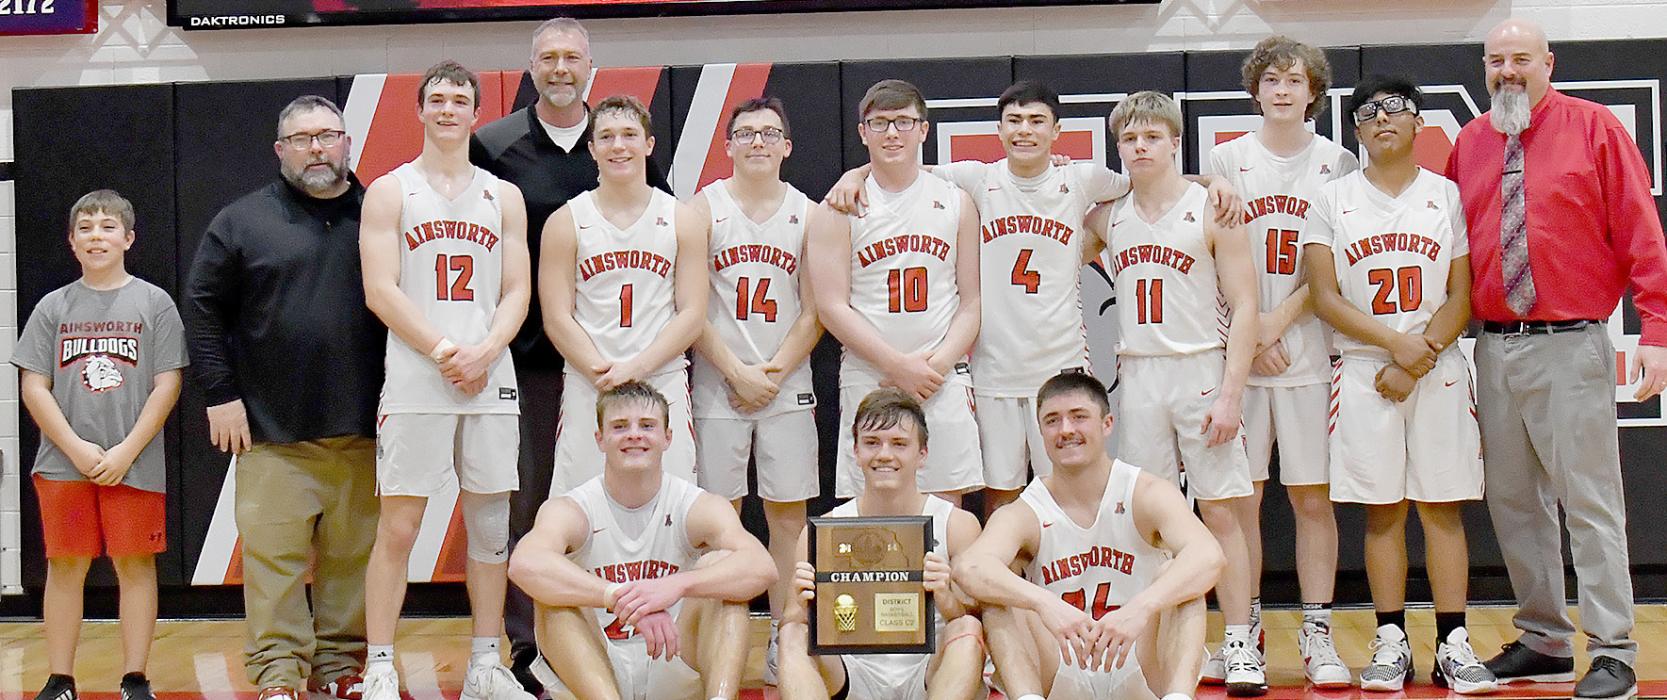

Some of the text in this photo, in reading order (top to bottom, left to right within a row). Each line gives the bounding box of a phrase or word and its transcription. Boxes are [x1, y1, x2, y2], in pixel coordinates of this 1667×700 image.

[190, 15, 286, 26] DAKTRONICS
[1244, 194, 1311, 224] AINSWOR
[404, 220, 499, 253] AINSWORTH
[982, 215, 1074, 246] AINSWORTH
[579, 249, 671, 282] AINSWORTH
[714, 244, 797, 276] AINSWORTH
[857, 234, 951, 268] AINSWORTH
[1265, 228, 1299, 275] 15
[1344, 233, 1441, 267] AINSWORTH
[435, 253, 474, 301] 12
[1011, 248, 1041, 294] 4
[619, 284, 633, 328] 1
[736, 276, 778, 322] 14
[887, 266, 928, 313] 10
[1136, 278, 1163, 324] 11
[1368, 265, 1423, 316] 20
[60, 321, 143, 335] AINSWORTH
[61, 337, 138, 364] BULLDOGS
[587, 560, 680, 584] INSWRTH
[830, 571, 909, 582] CHAMPION
